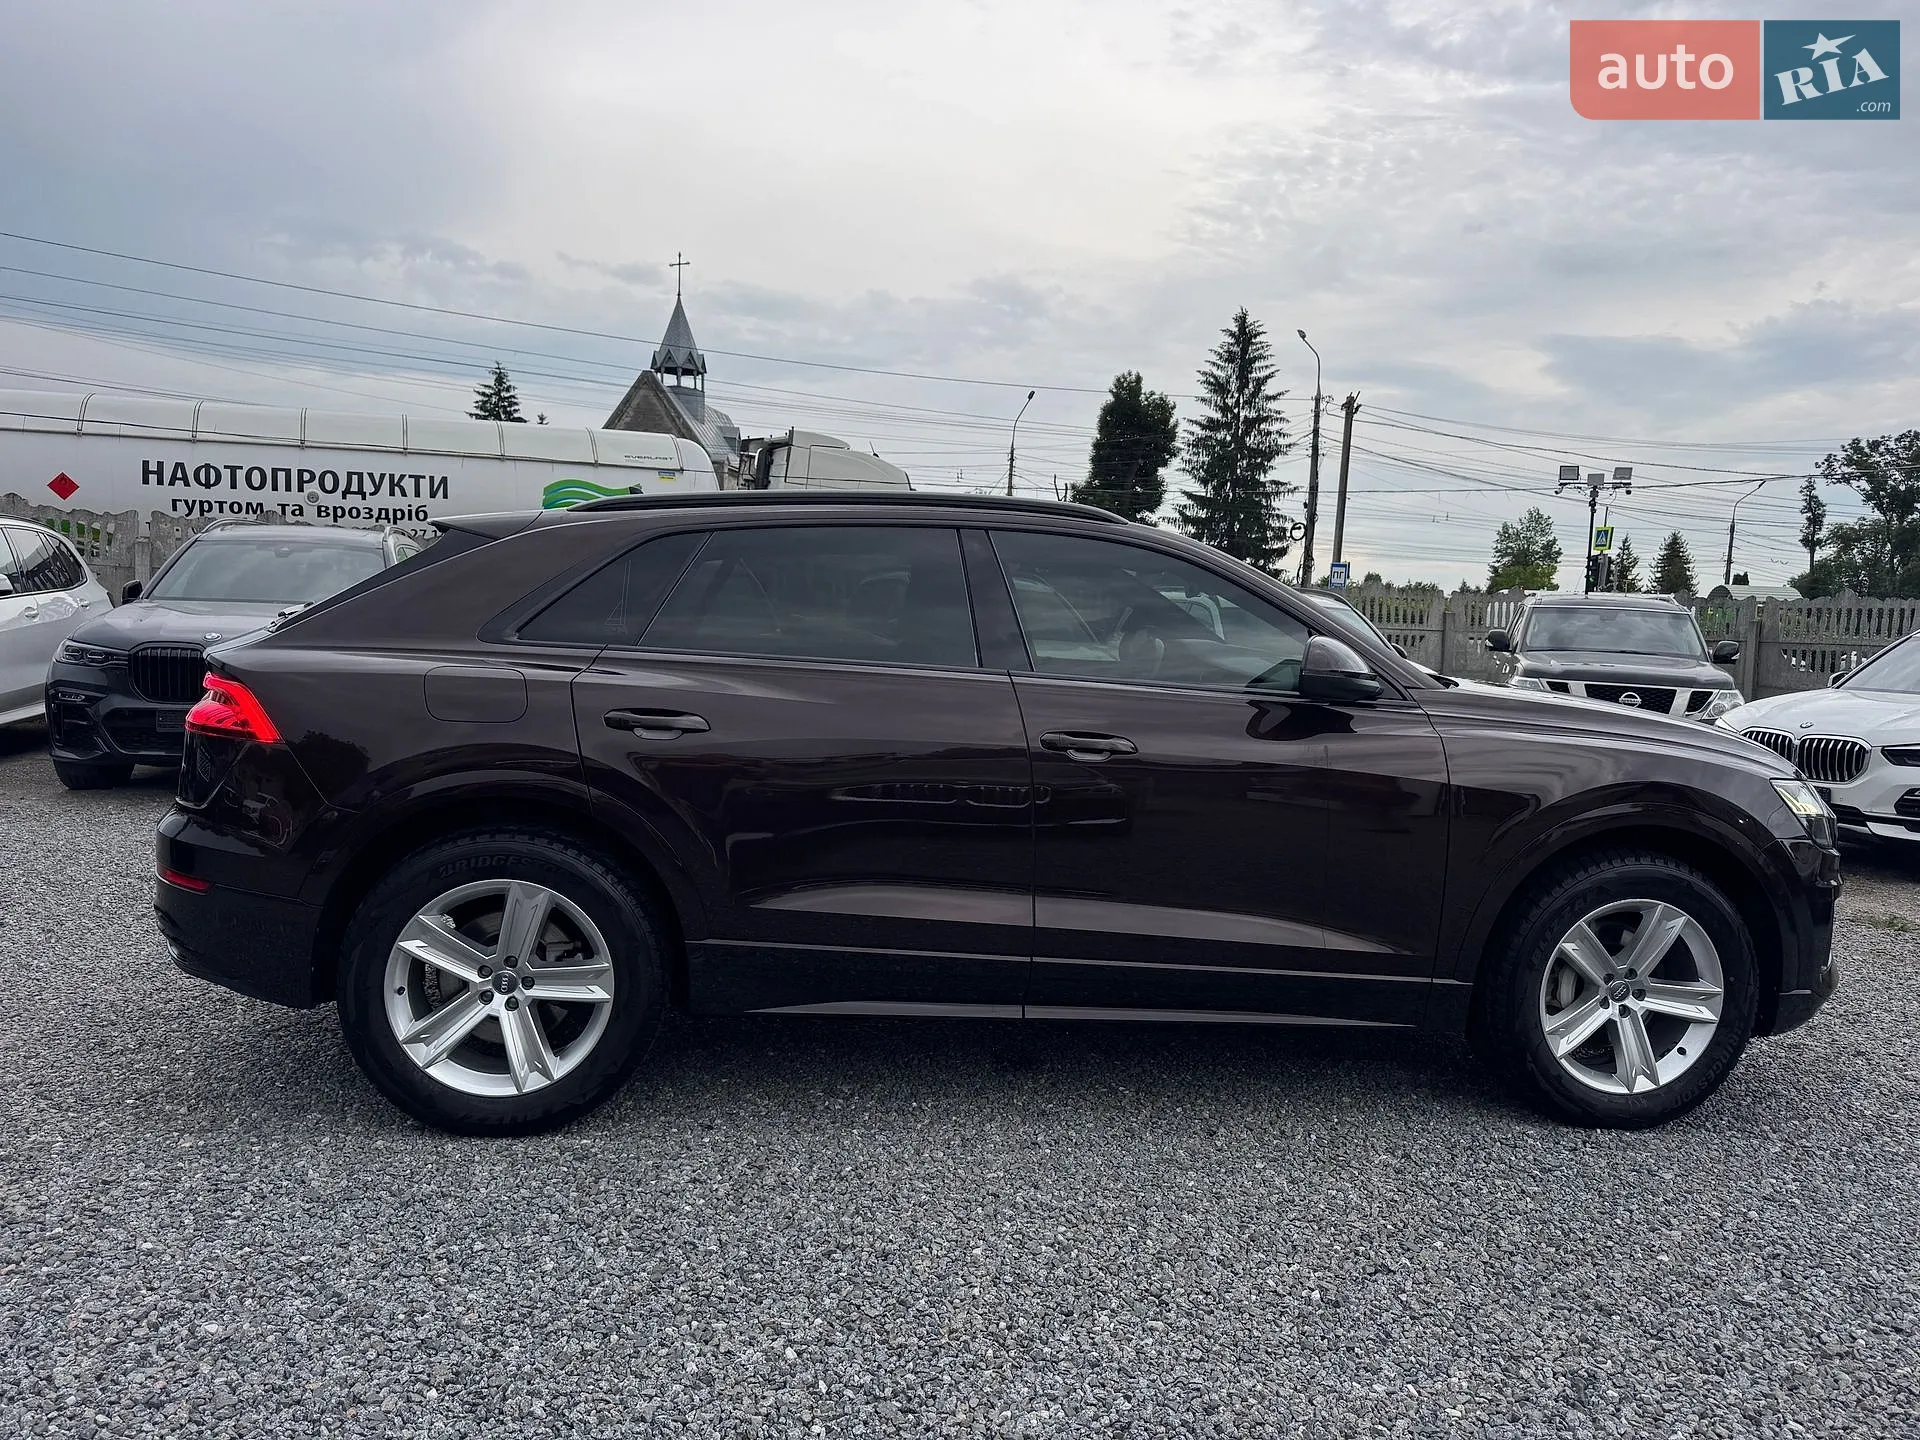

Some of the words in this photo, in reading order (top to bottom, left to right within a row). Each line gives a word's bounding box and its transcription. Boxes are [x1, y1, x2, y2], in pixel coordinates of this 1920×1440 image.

[141, 459, 449, 501] НАФТОПРОДУКТИ
[171, 498, 264, 517] гуртом
[276, 503, 304, 518] та
[316, 503, 429, 525] вроздріб
